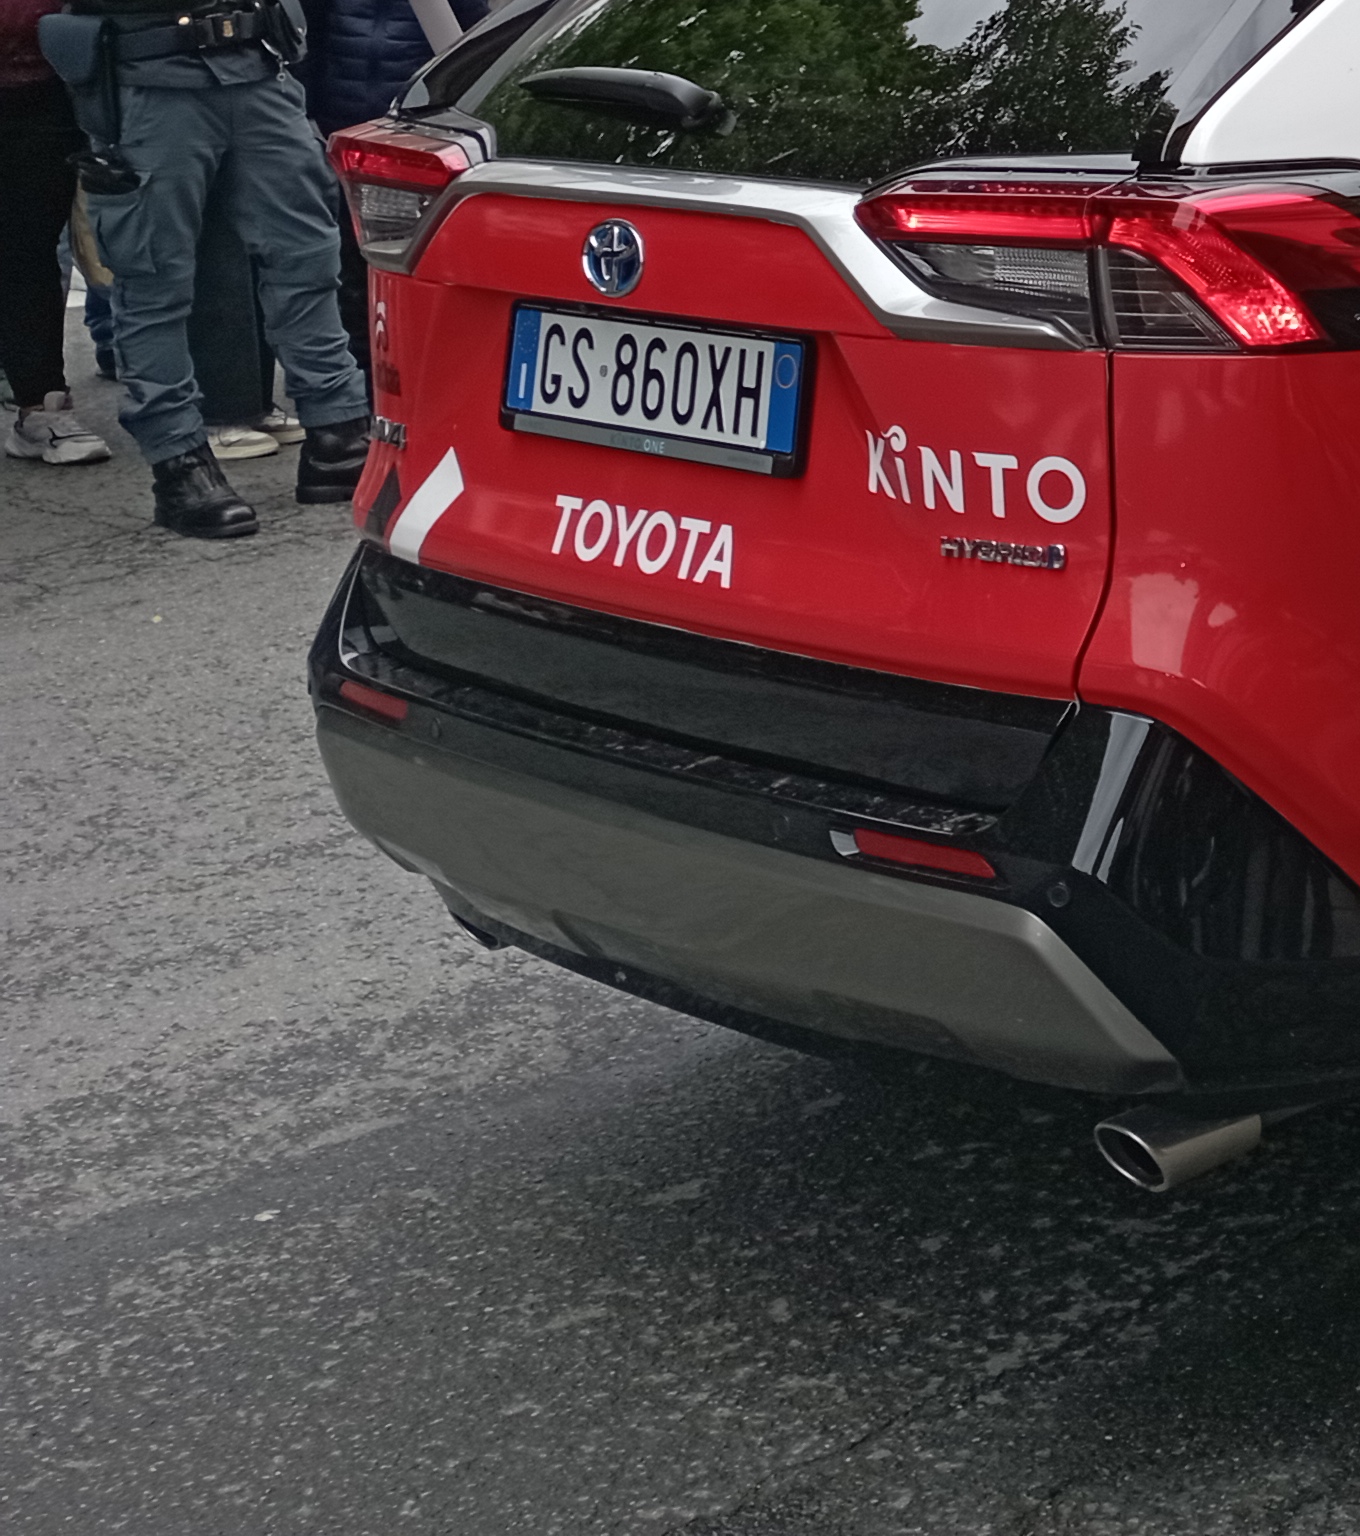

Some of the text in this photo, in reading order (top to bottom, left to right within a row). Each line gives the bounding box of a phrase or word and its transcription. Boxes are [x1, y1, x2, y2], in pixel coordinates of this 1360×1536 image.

[540, 323, 594, 409] GS
[611, 333, 765, 438] 860XH
[643, 438, 665, 454] ONE
[551, 494, 733, 589] TOYOTA
